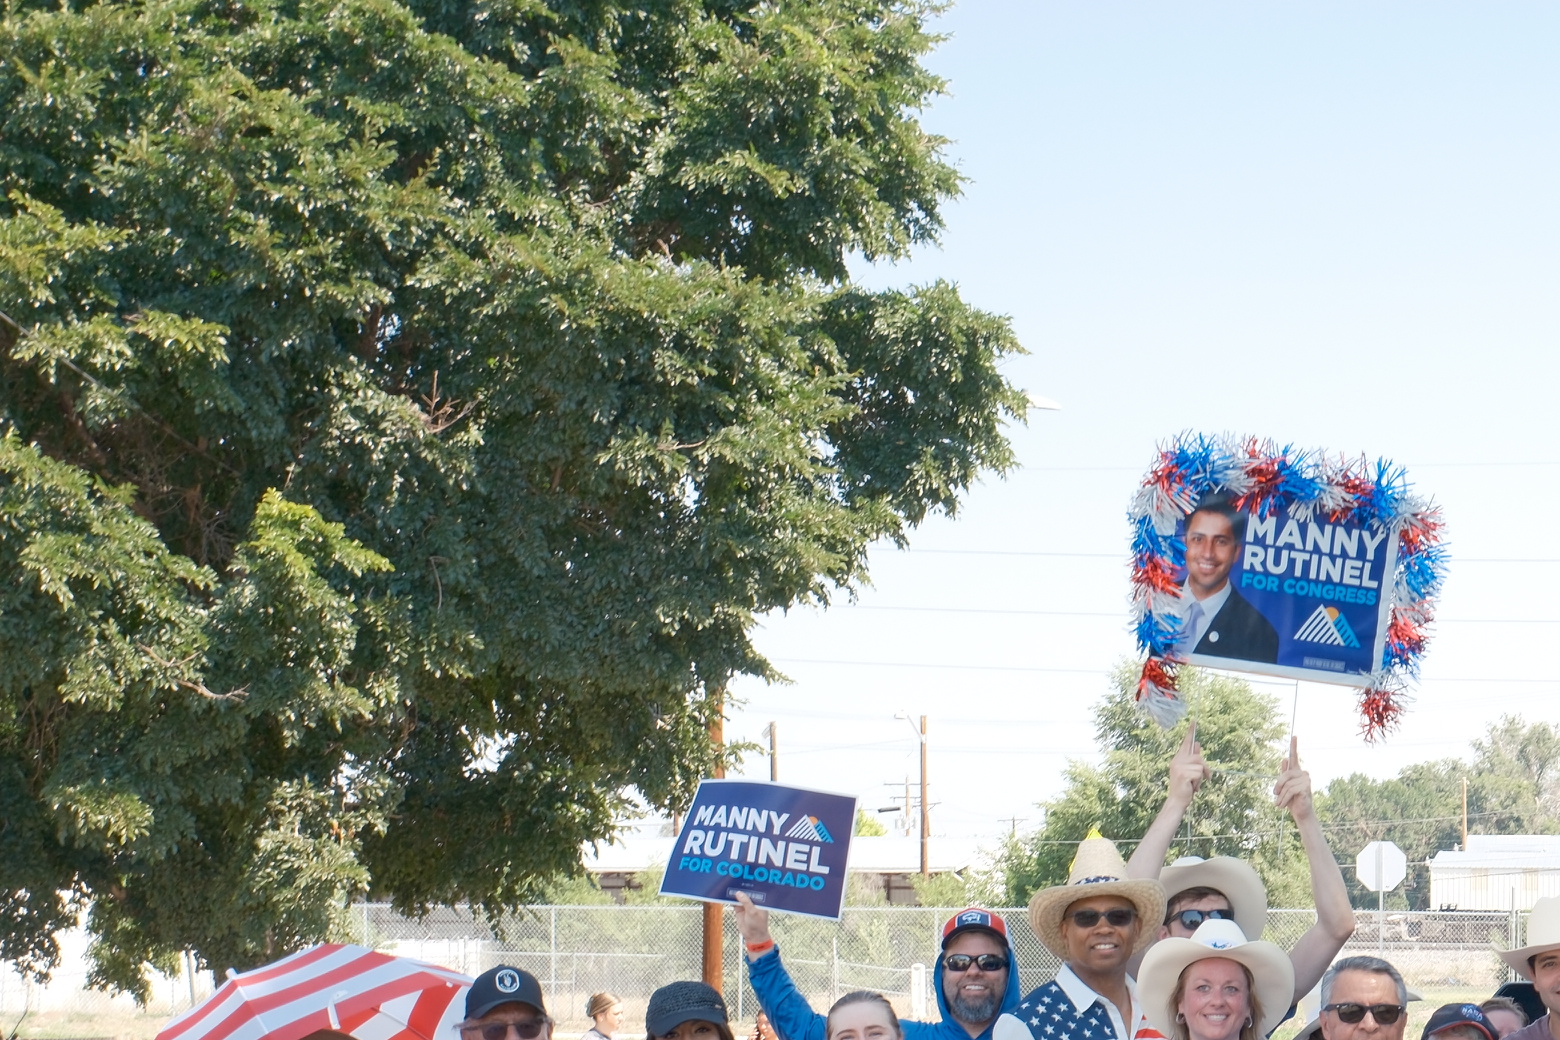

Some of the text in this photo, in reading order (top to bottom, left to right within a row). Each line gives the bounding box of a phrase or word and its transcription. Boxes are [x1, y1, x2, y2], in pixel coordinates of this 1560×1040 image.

[1245, 514, 1386, 560] MANNY
[1242, 544, 1378, 589] RUTINEL
[1241, 572, 1377, 606] FOR CONGRESS
[693, 805, 790, 835] MANNY
[683, 829, 830, 874] RUTINEL
[679, 856, 825, 891] FOR COLORADO
